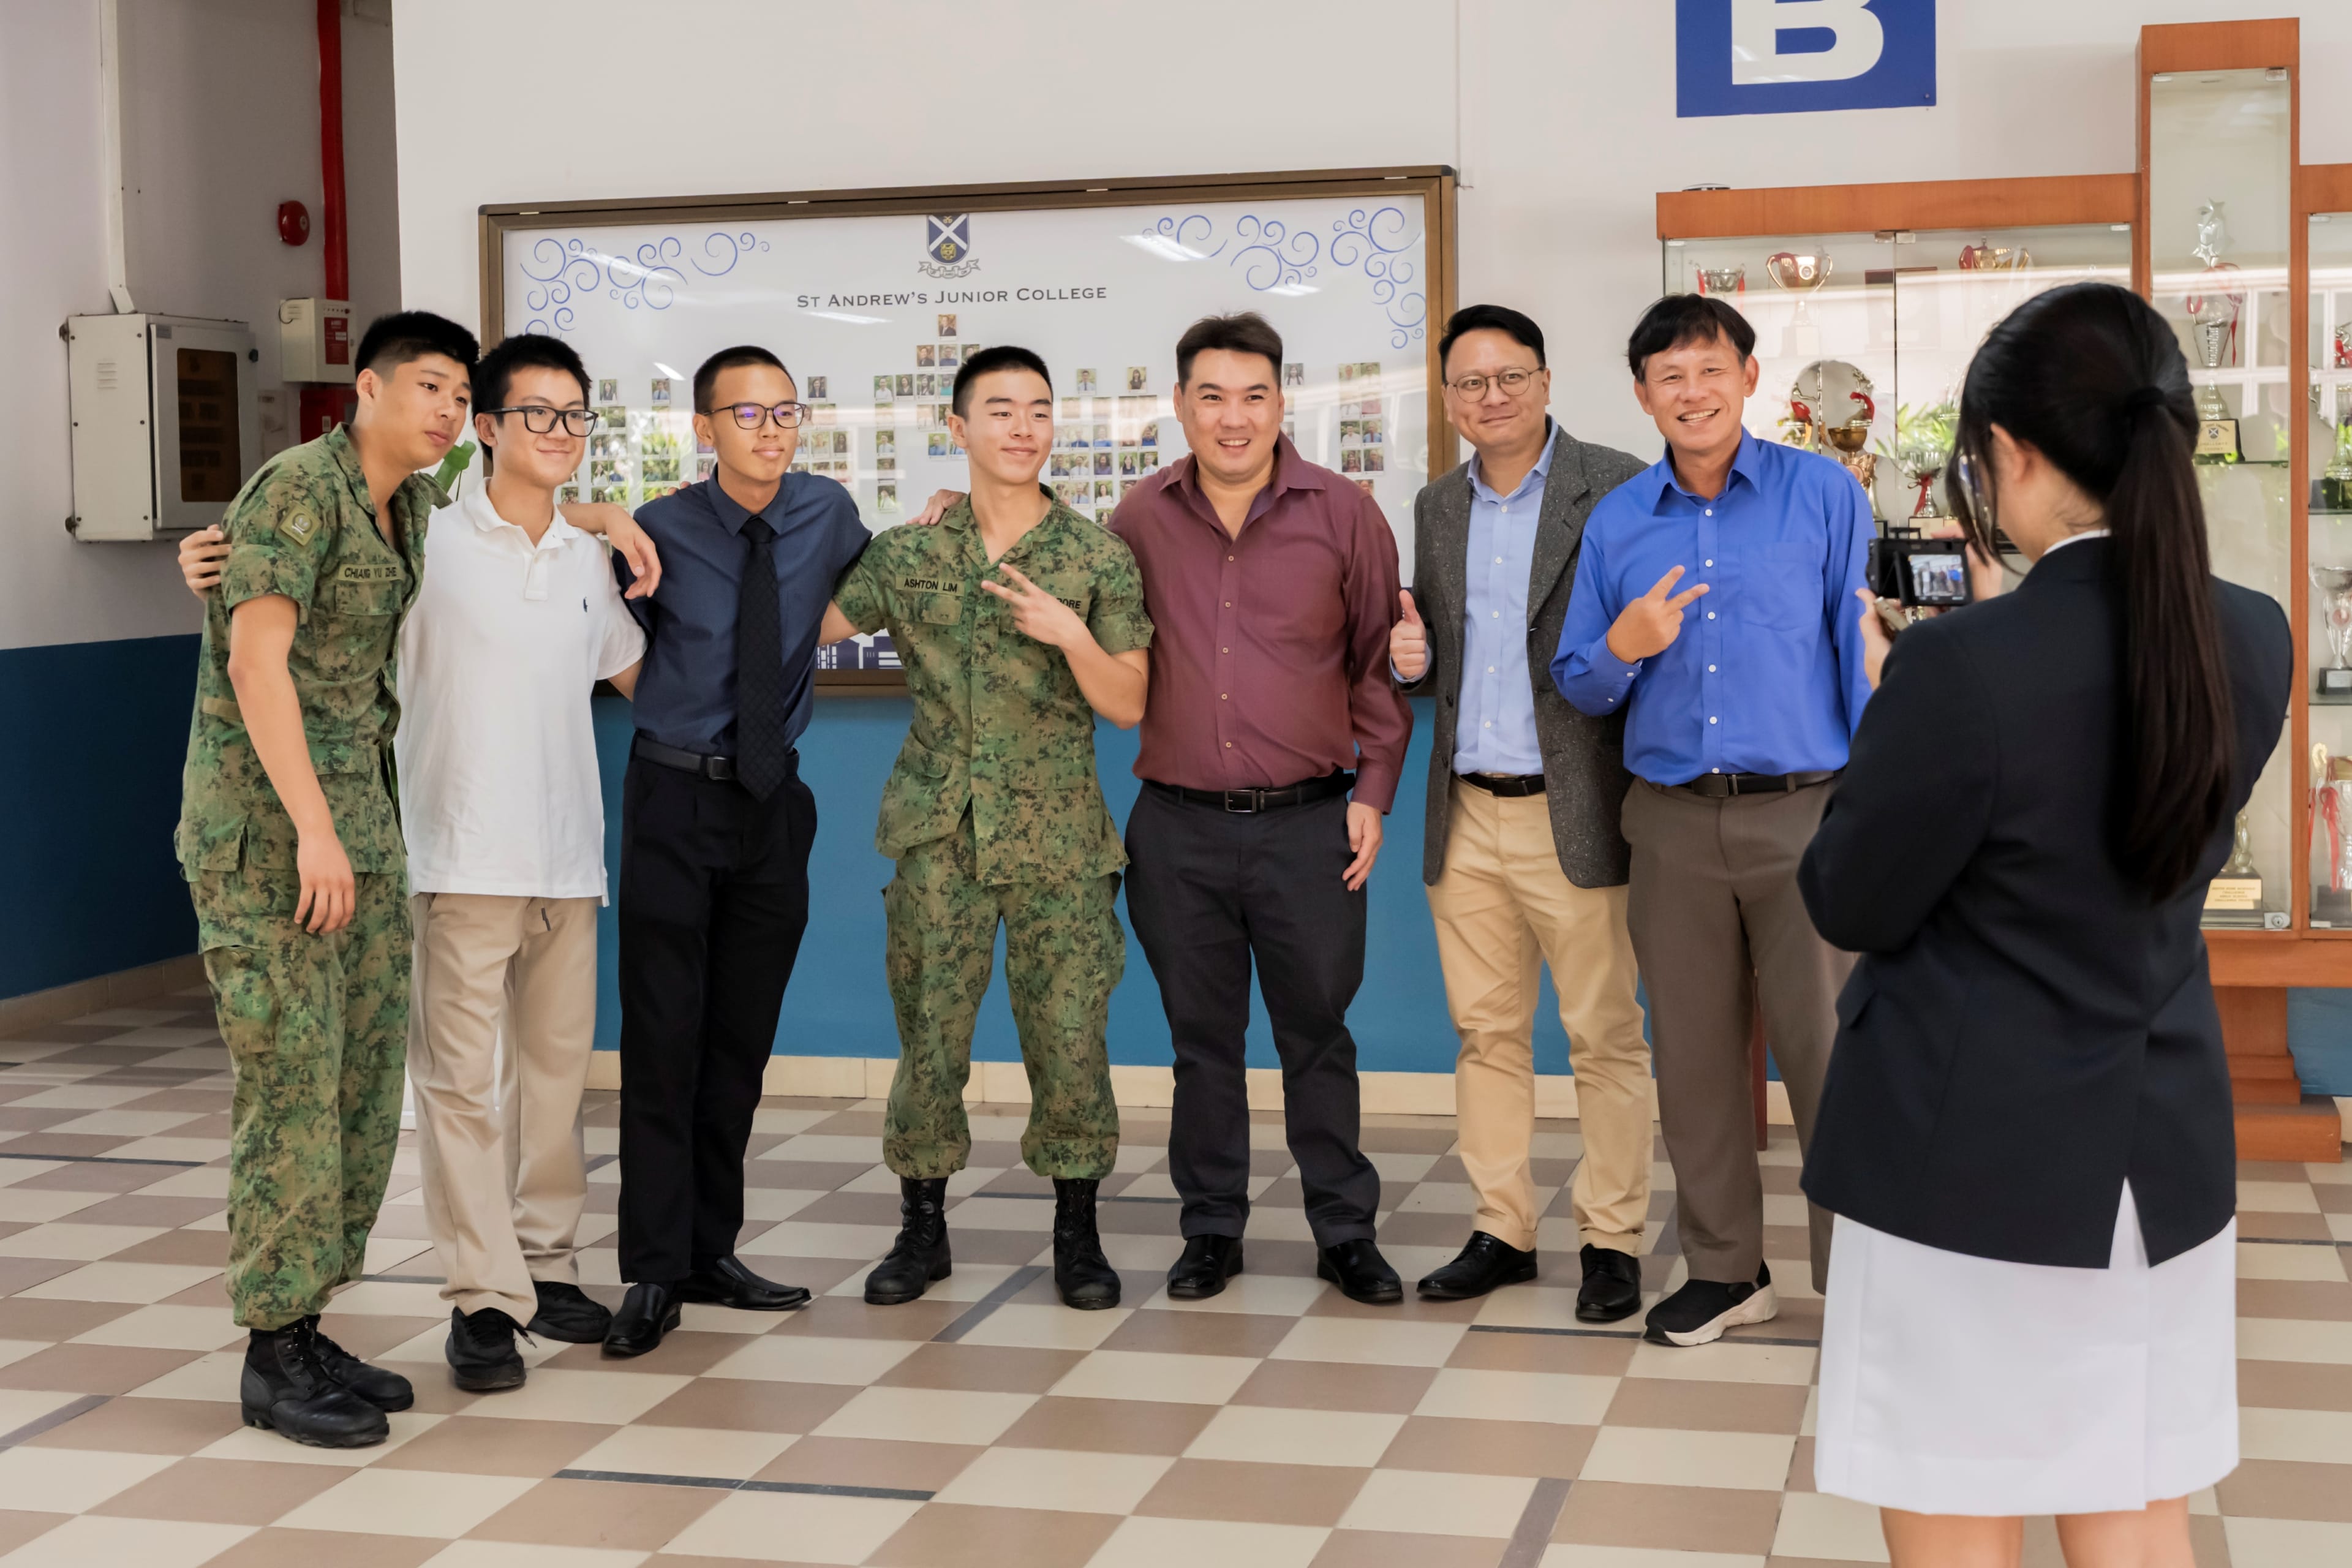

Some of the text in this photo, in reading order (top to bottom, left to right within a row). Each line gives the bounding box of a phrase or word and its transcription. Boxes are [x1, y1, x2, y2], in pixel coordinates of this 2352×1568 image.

[1732, 0, 1884, 85] B
[827, 291, 927, 307] ANDREW'S
[935, 290, 1008, 304] JUNIOR
[1016, 287, 1107, 301] COLLEGE
[374, 567, 382, 578] YU
[904, 577, 958, 593] ASHTON LIM
